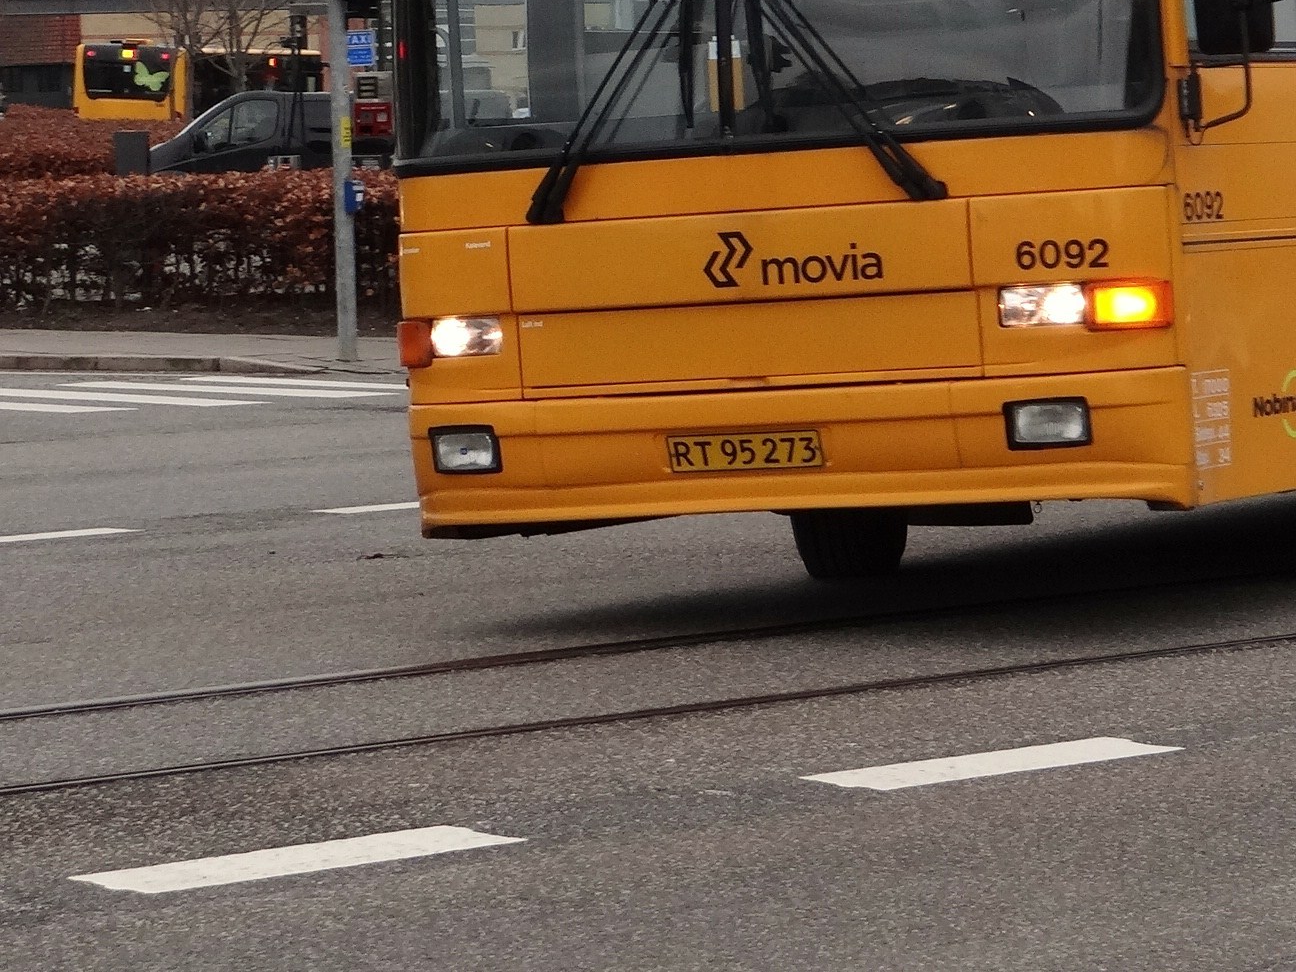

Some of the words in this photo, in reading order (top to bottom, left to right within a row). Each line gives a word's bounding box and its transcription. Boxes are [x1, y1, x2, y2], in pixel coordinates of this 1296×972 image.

[1183, 191, 1225, 221] 6092
[761, 242, 885, 286] movia
[1015, 238, 1110, 271] 6092
[673, 441, 712, 467] RT
[720, 439, 756, 465] 95
[762, 437, 817, 464] 273
